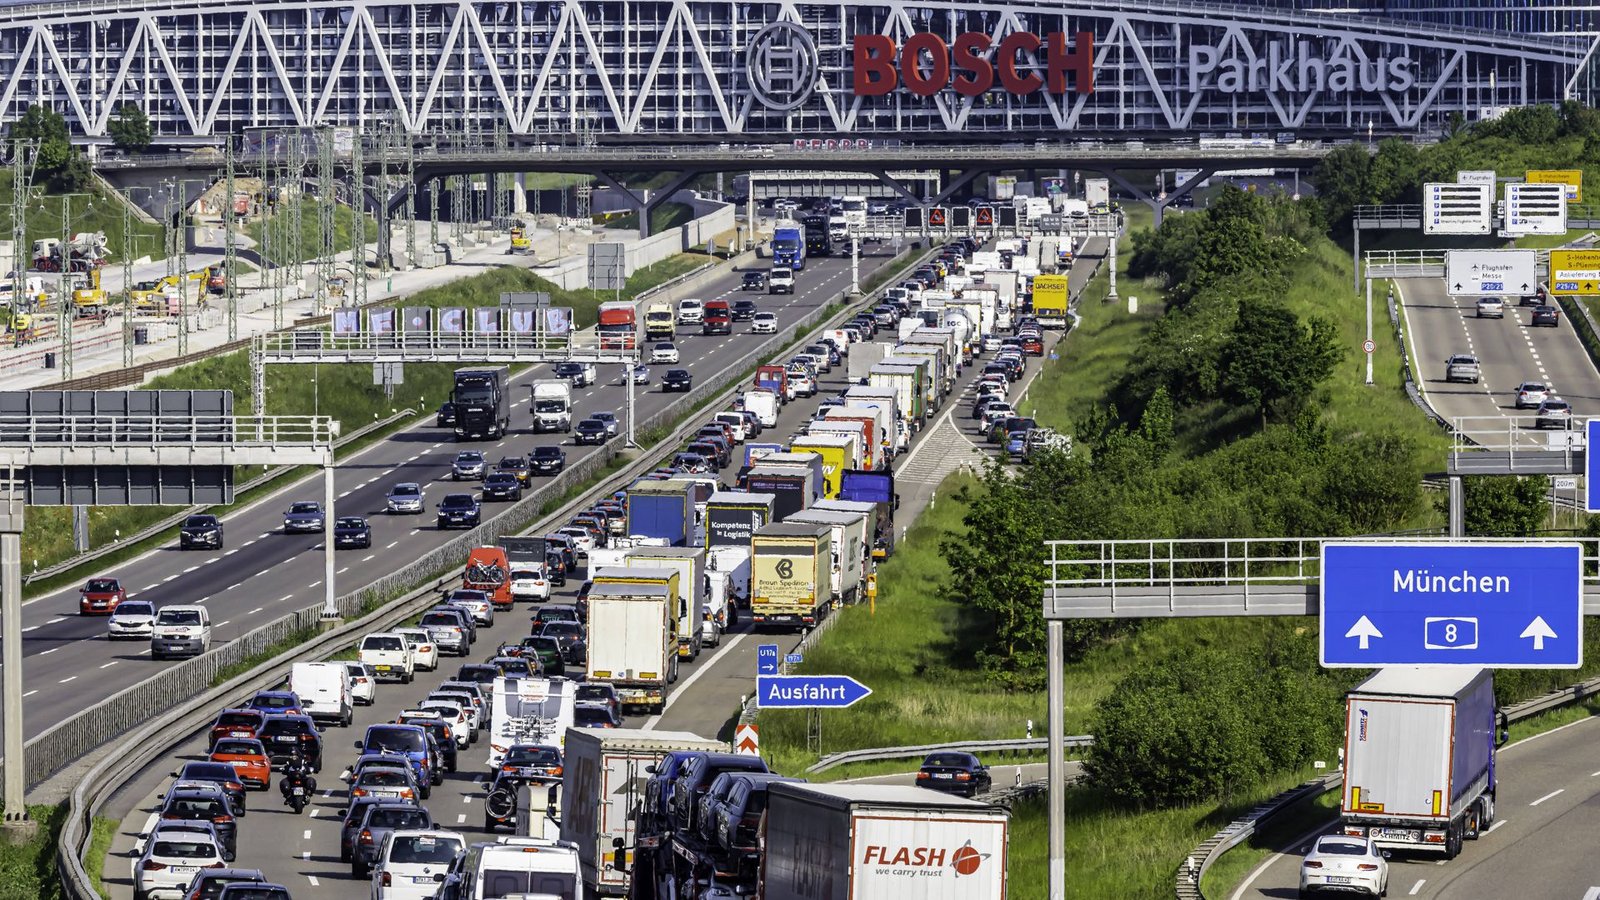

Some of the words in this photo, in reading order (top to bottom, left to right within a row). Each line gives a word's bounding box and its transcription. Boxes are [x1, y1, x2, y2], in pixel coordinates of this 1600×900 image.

[853, 31, 1093, 96] BOSCH
[1188, 40, 1414, 93] Parkhaus
[1481, 264, 1513, 272] Flughafen
[711, 522, 751, 531] Kompetenz
[723, 530, 751, 539] Logistik
[1393, 569, 1510, 593] München
[1445, 623, 1457, 643] 8
[769, 683, 845, 700] Ausfahrt
[863, 845, 946, 867] FLASH
[892, 869, 917, 878] carry
[919, 869, 943, 877] trust
